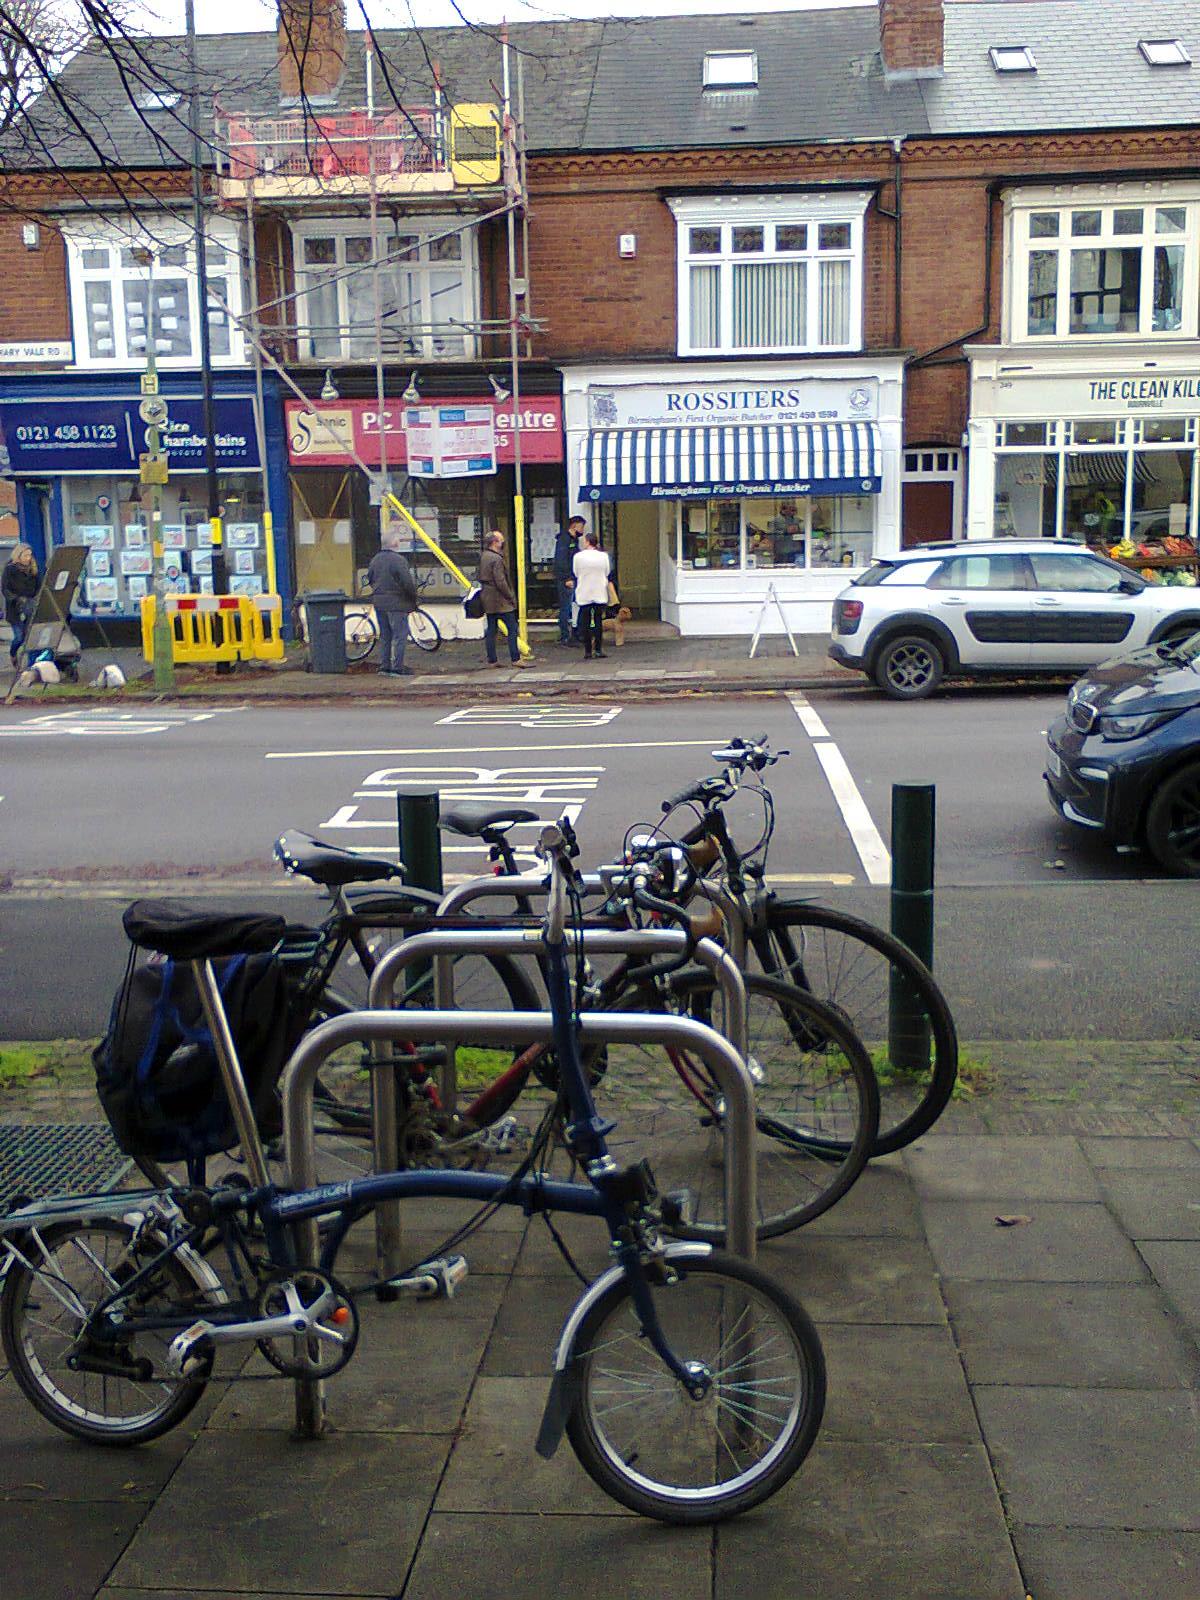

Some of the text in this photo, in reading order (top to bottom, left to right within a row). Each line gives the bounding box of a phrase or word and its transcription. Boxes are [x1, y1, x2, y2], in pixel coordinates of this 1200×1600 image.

[24, 347, 45, 356] VALE
[48, 347, 60, 356] RD
[1089, 381, 1117, 400] THE
[1121, 380, 1169, 400] CLEAN
[666, 389, 801, 411] ROSSITERS
[362, 410, 556, 430] PC entre
[686, 414, 704, 424] First
[707, 413, 739, 424] Organic
[741, 412, 774, 422] Butcher
[16, 424, 118, 441] 0121 458 1123
[736, 483, 772, 495] Organic
[773, 483, 811, 493] Butcher
